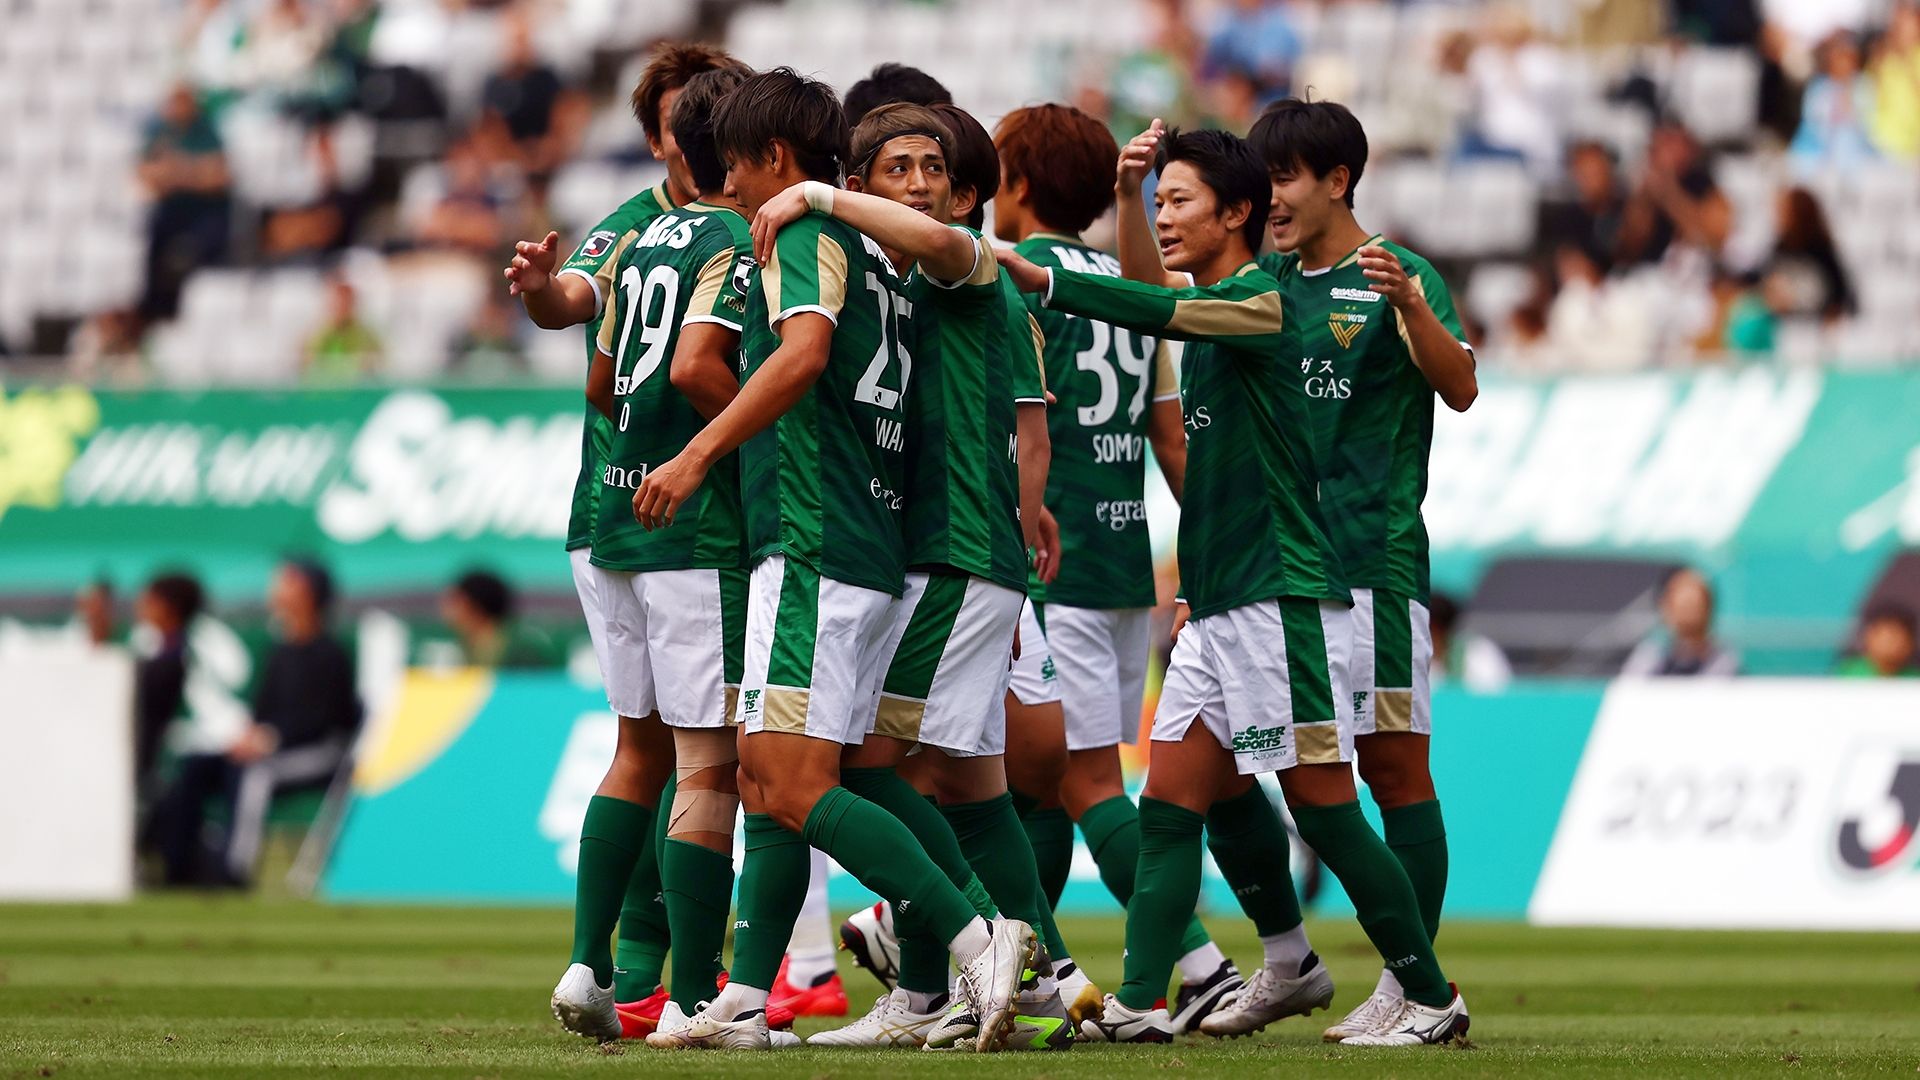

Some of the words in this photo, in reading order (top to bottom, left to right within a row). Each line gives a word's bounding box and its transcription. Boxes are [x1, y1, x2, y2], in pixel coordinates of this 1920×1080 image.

[854, 271, 913, 413] 25
[1076, 313, 1156, 426] 39
[1304, 376, 1352, 399] GAS
[876, 416, 904, 452] WA
[603, 463, 648, 490] and
[1231, 736, 1281, 751] SPORTS
[1245, 725, 1286, 740] SUPER
[1602, 765, 1802, 838] 2023
